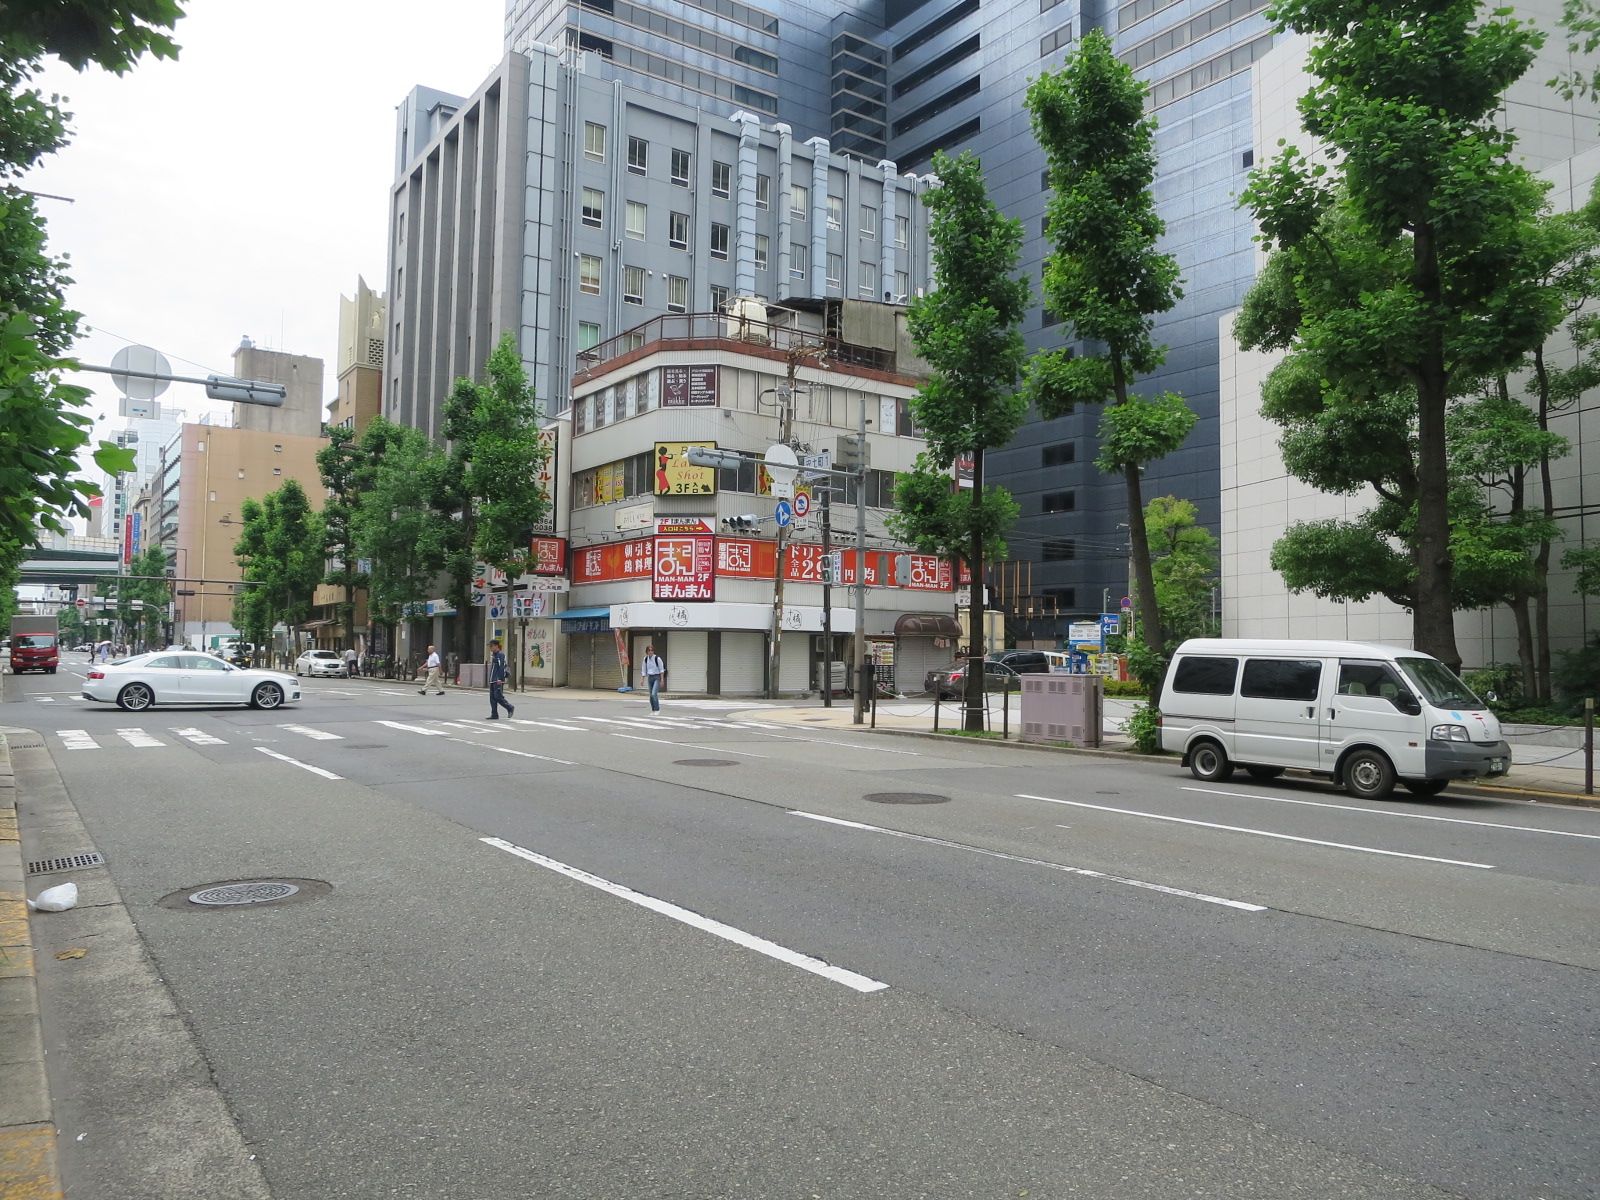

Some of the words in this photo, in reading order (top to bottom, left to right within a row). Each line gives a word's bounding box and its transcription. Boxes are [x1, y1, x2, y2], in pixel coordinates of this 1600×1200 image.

[675, 483, 690, 494] 3F
[790, 560, 800, 577] 全品
[697, 573, 710, 582] 2F
[660, 584, 711, 598] まんまん
